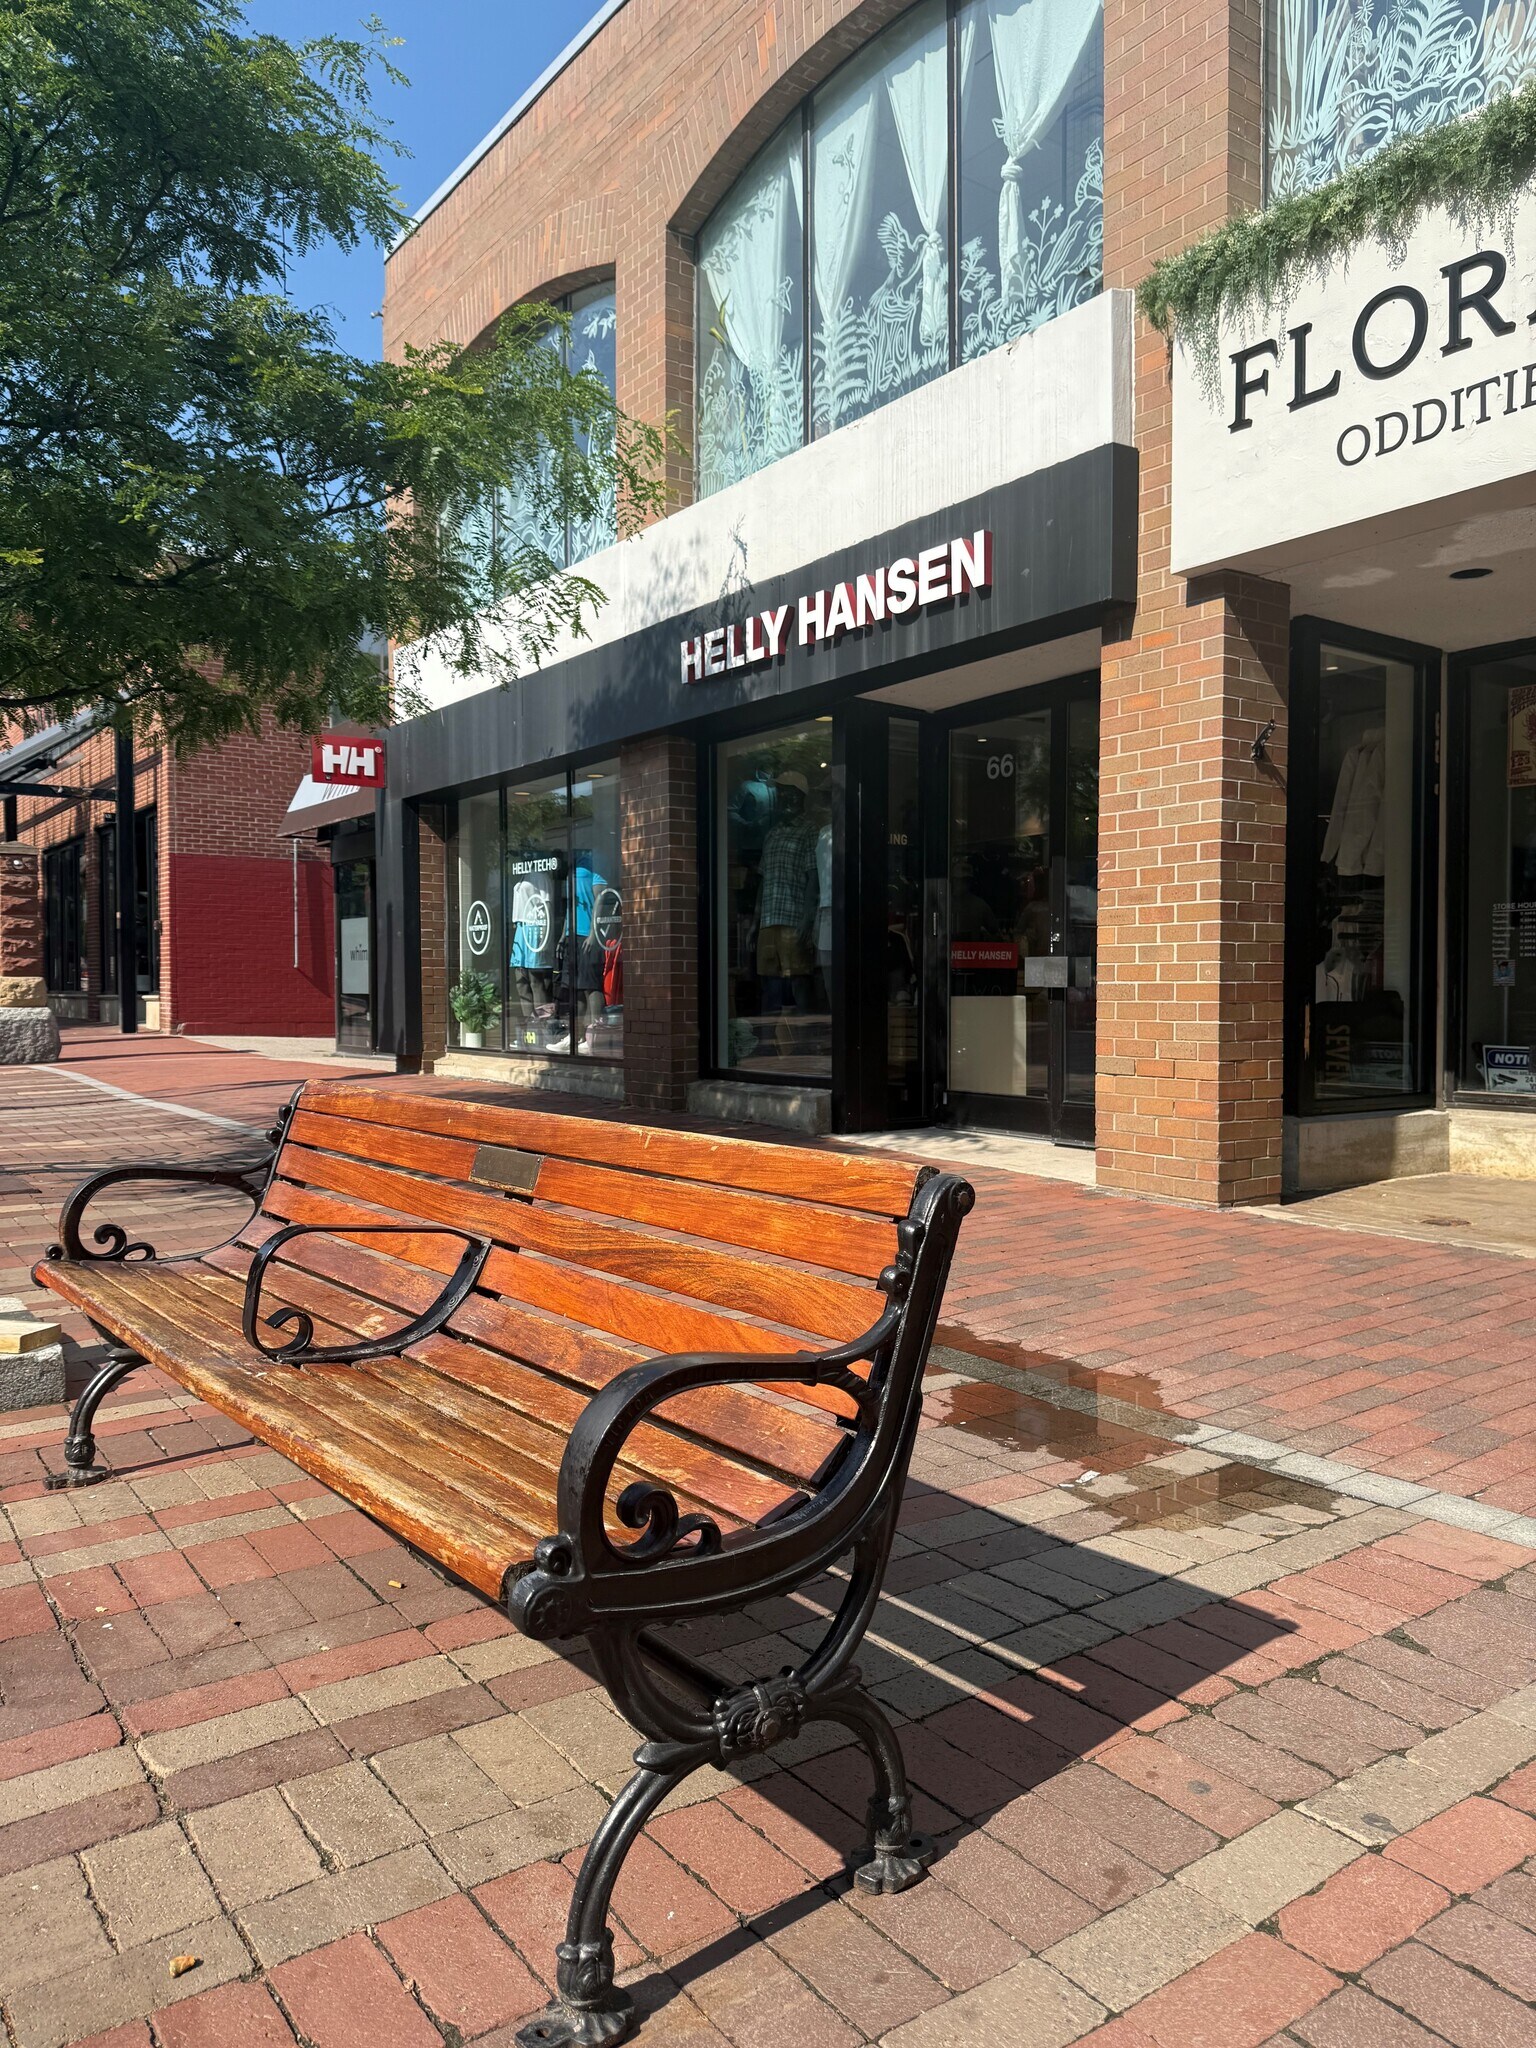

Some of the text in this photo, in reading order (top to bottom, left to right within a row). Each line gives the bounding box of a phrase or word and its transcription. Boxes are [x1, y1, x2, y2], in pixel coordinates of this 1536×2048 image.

[1227, 250, 1536, 434] FLOR
[680, 529, 992, 685] HELLY HANSEN
[986, 753, 1014, 780] 66
[887, 833, 908, 846] ING
[512, 860, 533, 875] HELLY
[951, 950, 1012, 961] HELLY HANSEN
[1494, 1053, 1530, 1065] NOTI
